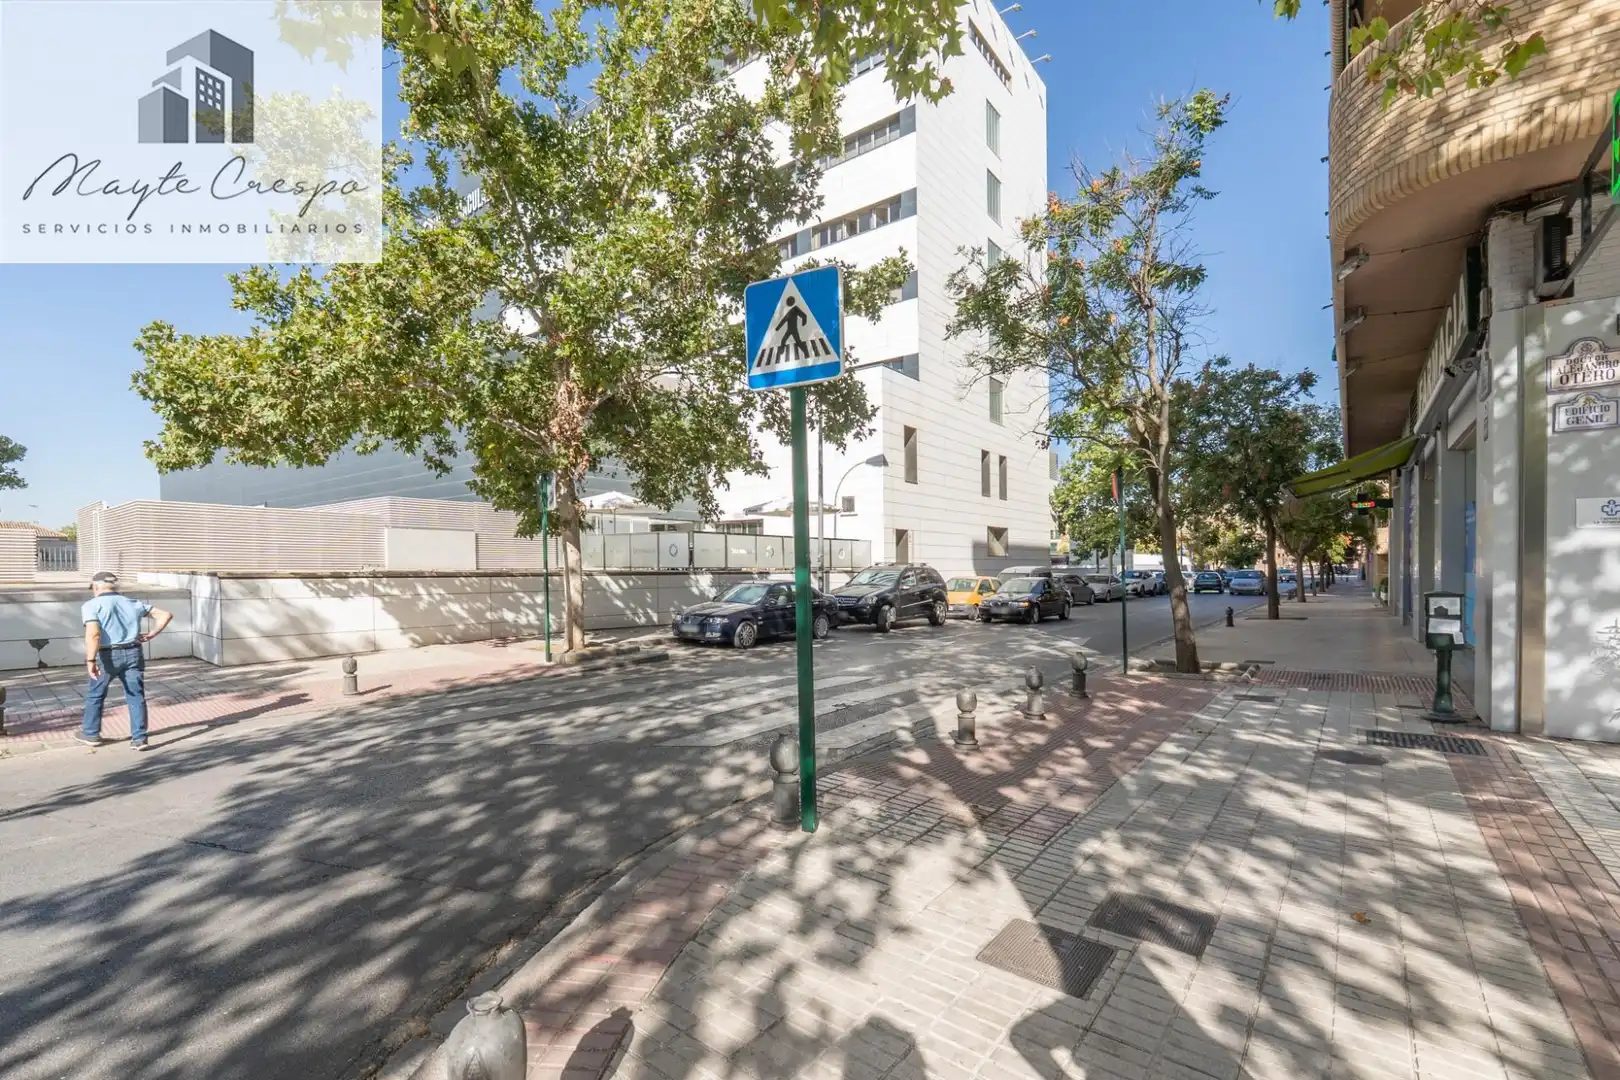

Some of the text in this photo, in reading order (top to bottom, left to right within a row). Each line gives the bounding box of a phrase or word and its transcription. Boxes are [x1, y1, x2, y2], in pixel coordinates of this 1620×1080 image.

[1566, 353, 1609, 366] DOCTOR
[1556, 358, 1620, 376] ALEJANDRO
[1559, 367, 1616, 386] OTERO
[1564, 403, 1611, 417] EDIFICIO
[1566, 413, 1609, 426] GENIL
